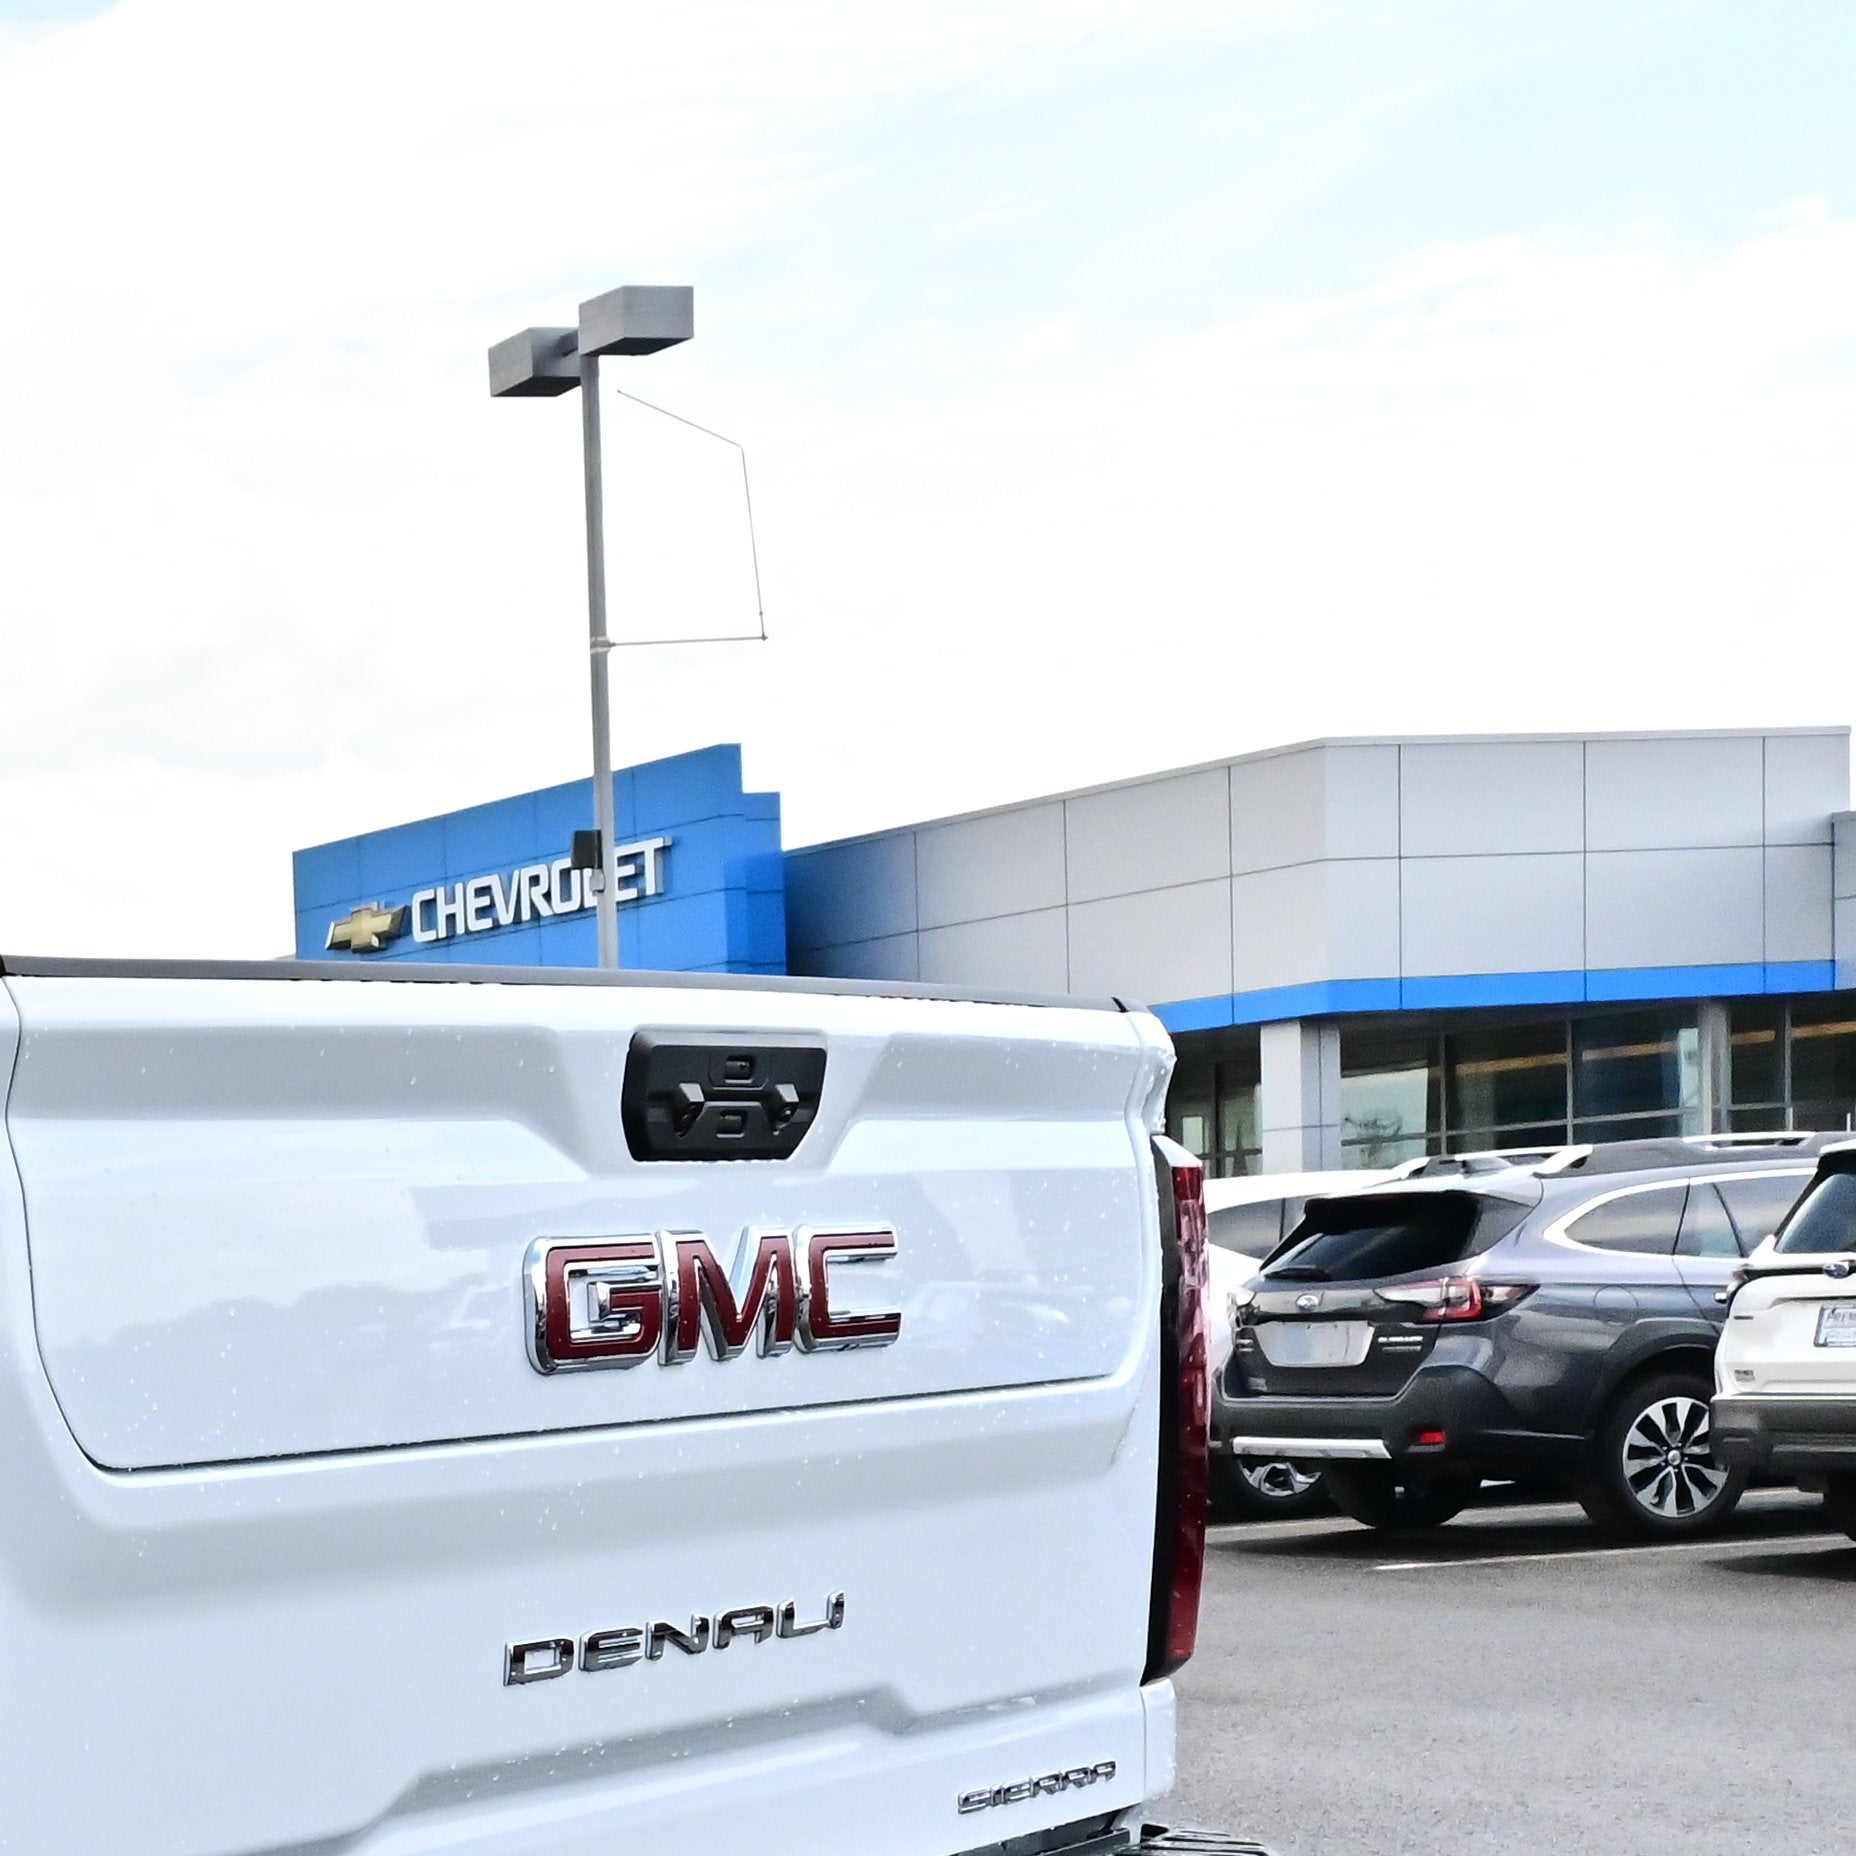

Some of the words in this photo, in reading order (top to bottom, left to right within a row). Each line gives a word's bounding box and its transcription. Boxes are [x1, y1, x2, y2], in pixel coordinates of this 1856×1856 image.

[524, 1225, 903, 1375] GMC
[503, 1592, 846, 1687] DENALI
[957, 1758, 1118, 1815] SIERRA
